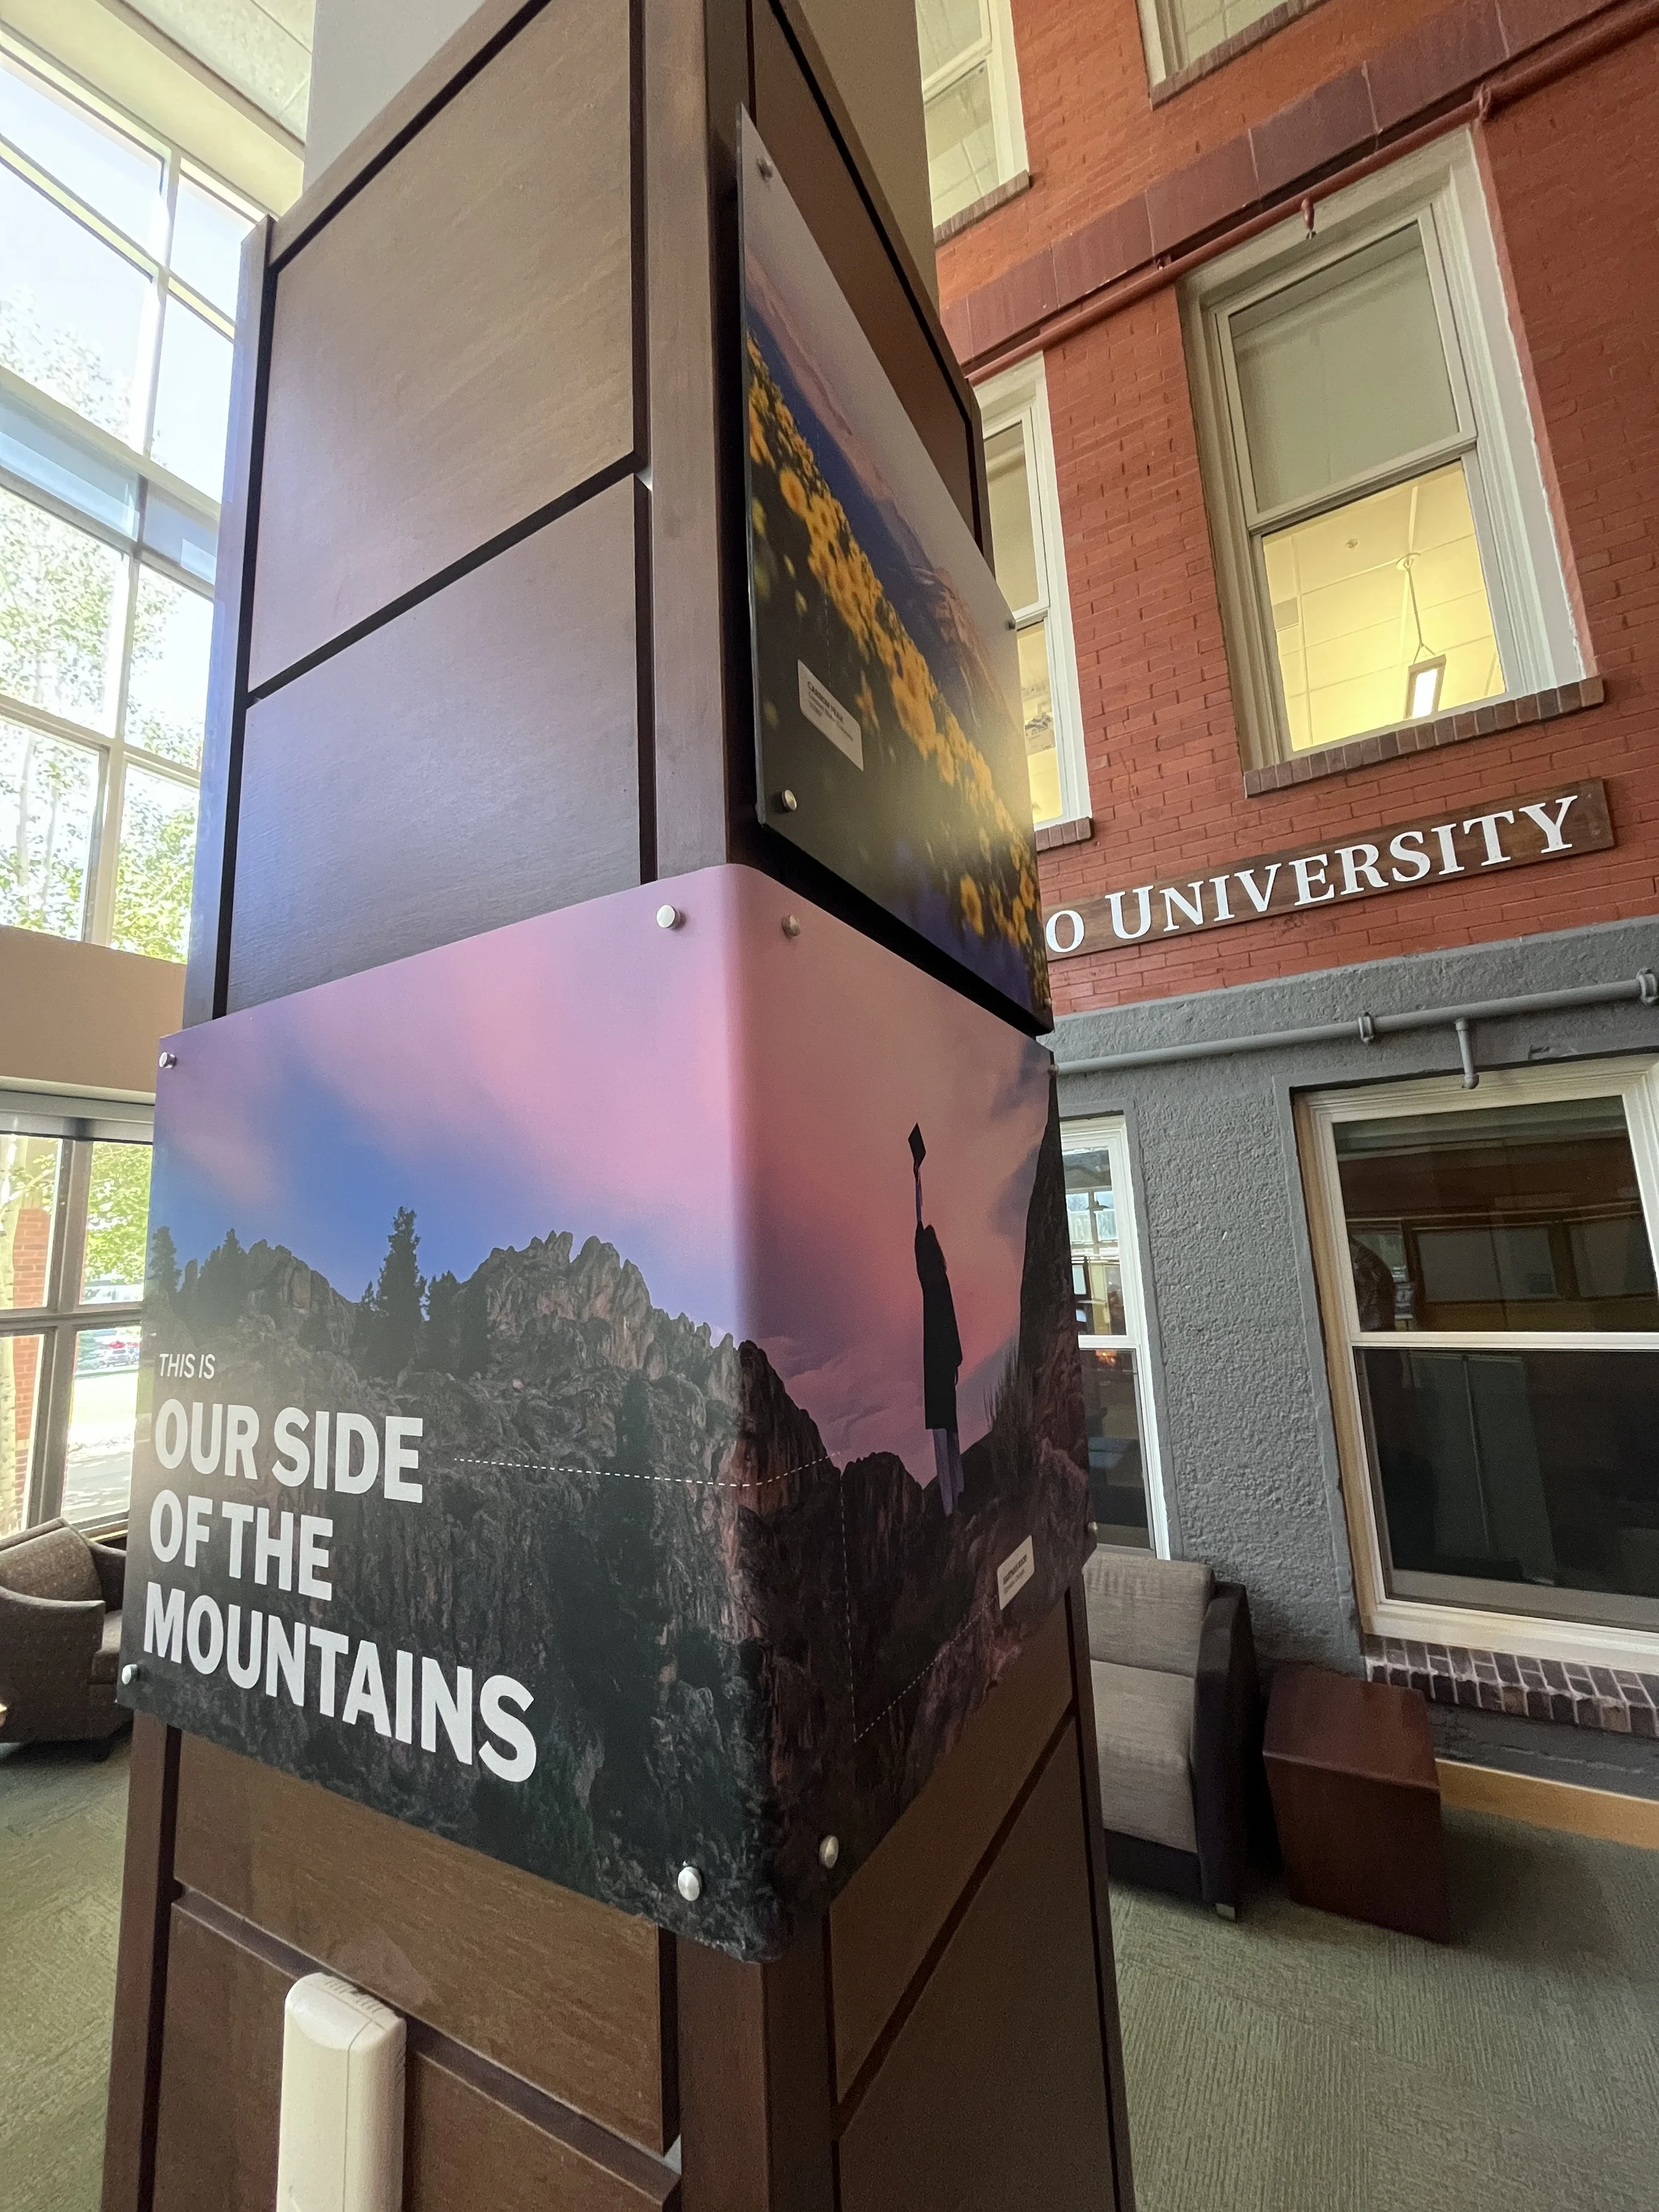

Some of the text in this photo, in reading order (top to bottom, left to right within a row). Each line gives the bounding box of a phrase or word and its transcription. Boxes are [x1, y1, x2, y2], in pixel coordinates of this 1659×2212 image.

[1105, 795, 1578, 939] UNIVERSITY
[159, 1353, 215, 1379] THIS IS
[155, 1398, 423, 1504] OUR SIDE
[150, 1489, 333, 1601] OF THE
[143, 1581, 536, 1783] MOUNTAINS
